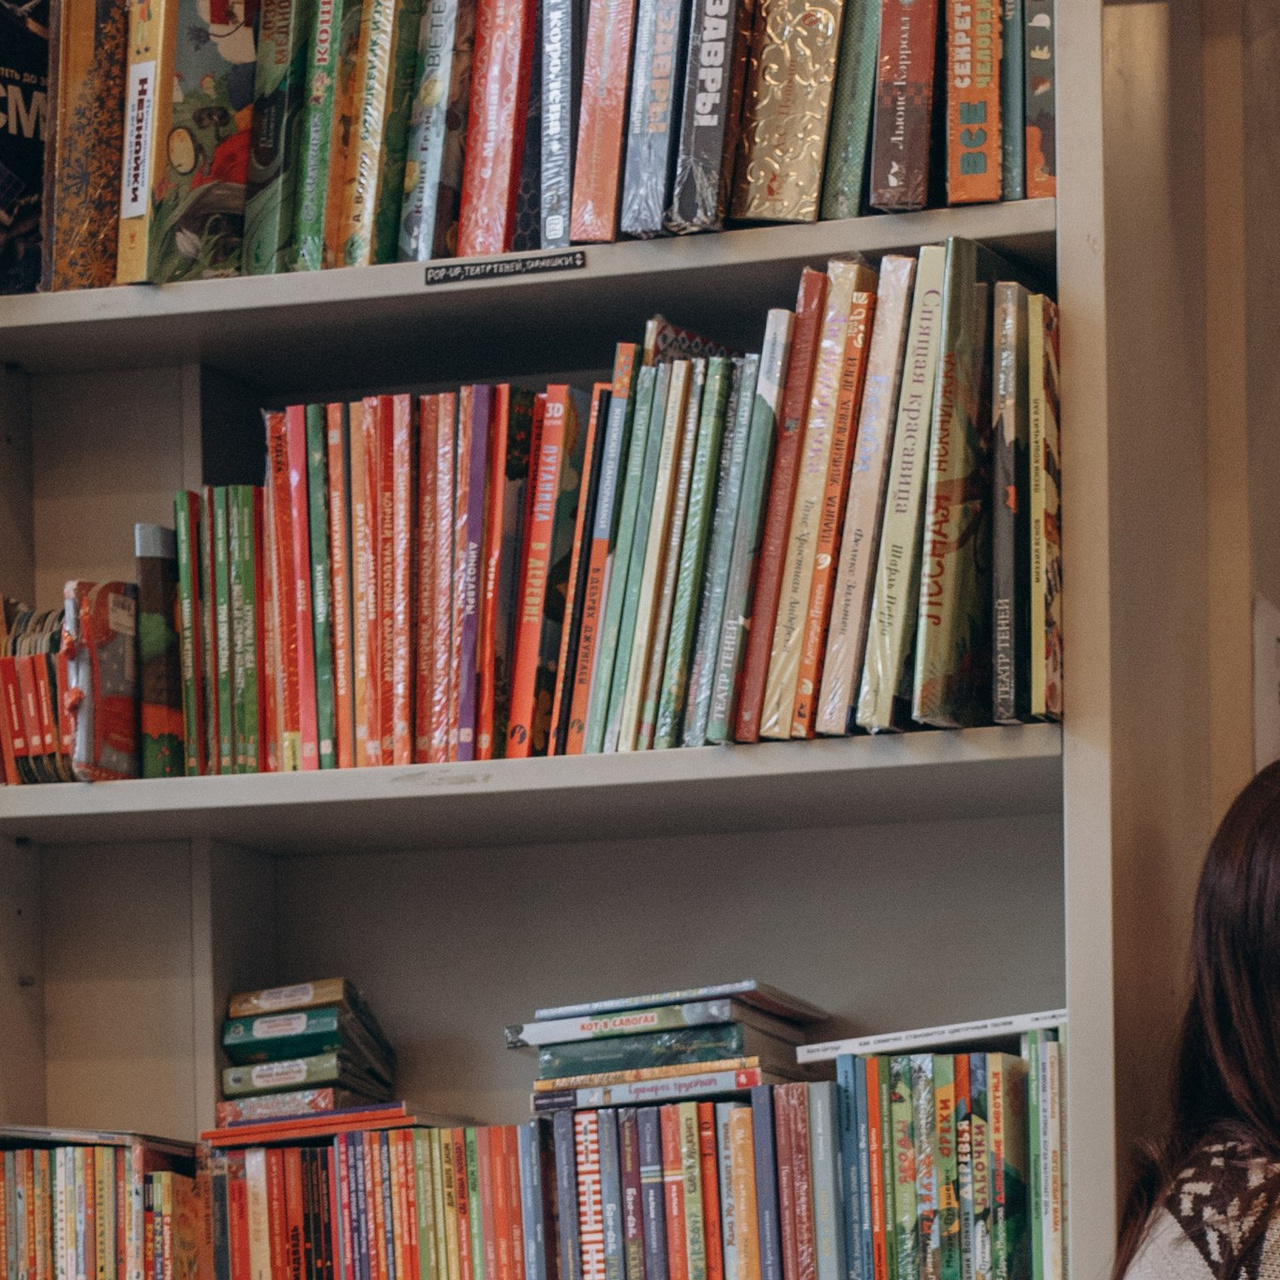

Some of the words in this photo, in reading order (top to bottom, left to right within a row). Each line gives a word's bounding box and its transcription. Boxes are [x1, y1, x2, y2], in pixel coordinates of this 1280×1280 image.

[958, 101, 987, 176] ВСЕ
[912, 289, 942, 385] Спящая
[894, 393, 922, 515] красавица
[466, 542, 478, 615] ДИНОЗАВРЫ
[523, 558, 545, 623] ДЕРЕВНЕ
[886, 544, 904, 590] Шарль
[879, 594, 897, 637] Перро
[936, 1099, 951, 1158] ОРЕХИ
[957, 1121, 972, 1200] ДЕРЕВЬЯ
[974, 1124, 987, 1208] БАБОЧКИ
